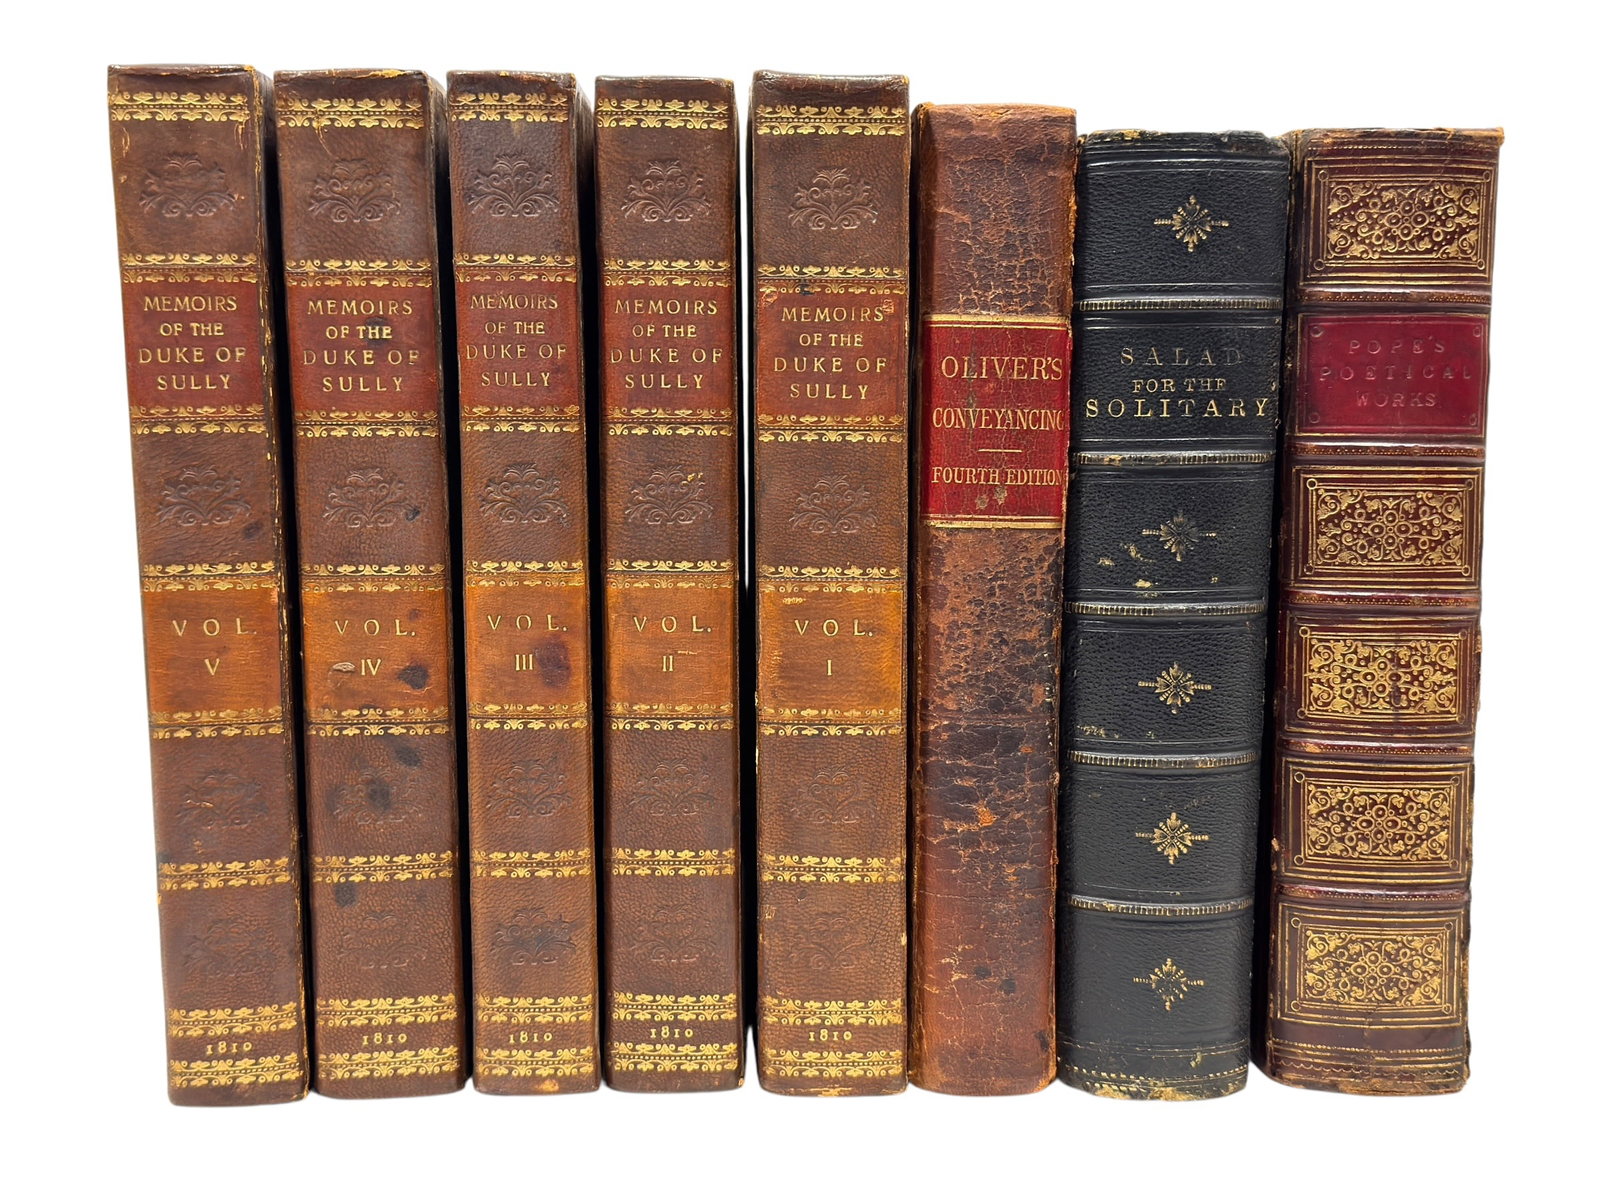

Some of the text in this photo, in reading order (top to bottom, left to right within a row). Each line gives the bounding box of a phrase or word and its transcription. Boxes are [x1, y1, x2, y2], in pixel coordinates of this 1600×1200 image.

[143, 296, 238, 312] MEMOIRS
[306, 299, 413, 315] MEMOIRS
[470, 295, 558, 310] MEMOIRS
[614, 299, 718, 315] MEMOIRS
[781, 307, 884, 322] MEMOIRS
[160, 322, 225, 337] OF THE
[325, 325, 393, 340] OF THE
[485, 321, 546, 335] OF THE
[632, 324, 697, 338] OF THE
[799, 333, 864, 348] OF THE
[138, 346, 247, 364] DUKE OF
[303, 350, 420, 365] DUKE OF
[466, 344, 568, 360] DUKE OF
[610, 347, 723, 364] DUKE OF
[1120, 346, 1243, 366] SALAD
[774, 357, 887, 373] DUKE OF
[941, 355, 1063, 381] OLIVER'S
[1319, 365, 1472, 381] POETICAL
[157, 374, 232, 391] SULLY
[322, 376, 403, 393] SULLY
[481, 371, 551, 387] SULLY
[625, 374, 704, 389] SULLY
[1131, 378, 1227, 393] FOR THE
[790, 384, 869, 400] SULLY
[1356, 391, 1437, 407] WORKS
[1085, 397, 1269, 418] SOLITARY
[932, 406, 1065, 431] CONVEYANCING
[931, 466, 1063, 486] FOURTH EDITION
[172, 617, 258, 637] VOL.
[334, 619, 417, 637] VOL.
[487, 614, 568, 632] VOL.
[633, 615, 712, 634] VOL.
[794, 619, 874, 637] VOL.
[204, 658, 221, 676] V
[360, 658, 382, 676] IV
[514, 654, 534, 671] III
[661, 655, 674, 672] II
[826, 659, 833, 676] I
[362, 1032, 407, 1045] 1810
[508, 1031, 553, 1044] 1810
[650, 1027, 694, 1040] 1810
[808, 1029, 853, 1042] 1810
[206, 1041, 252, 1055] 1810
